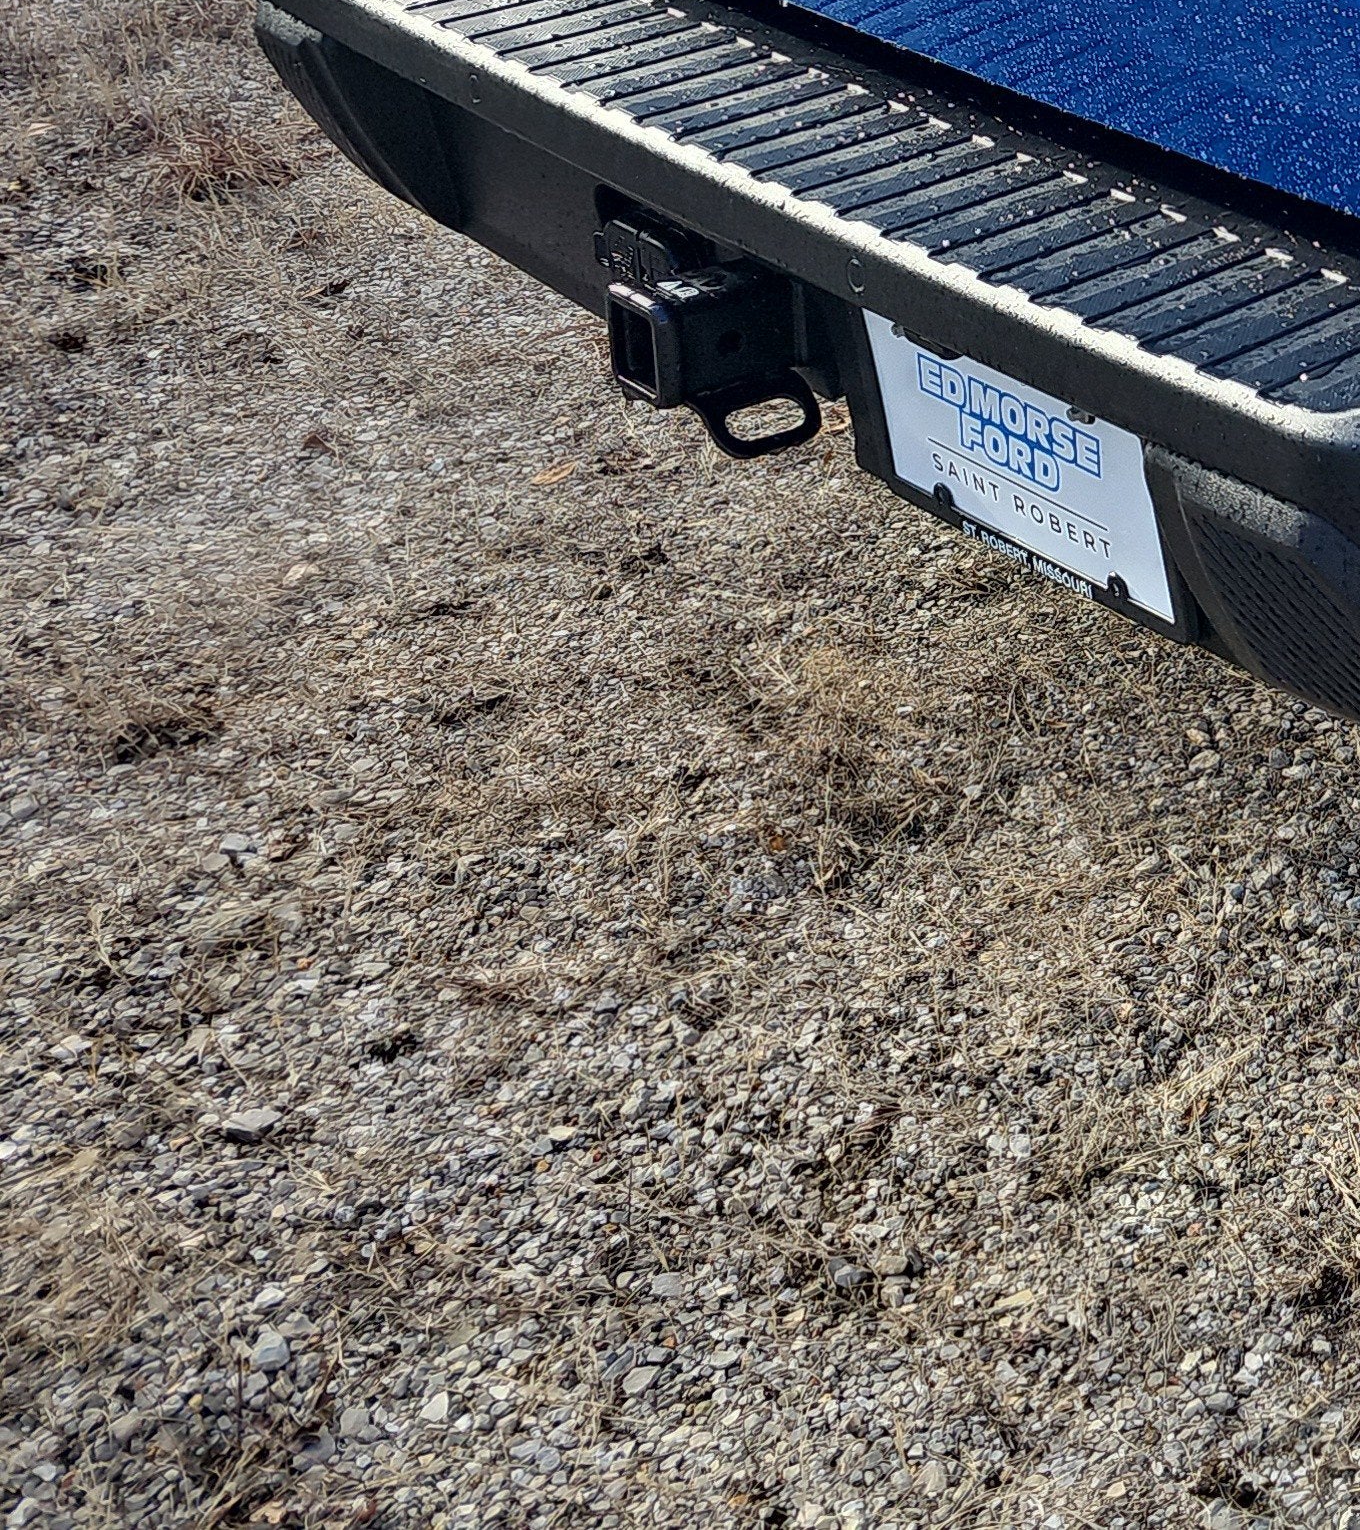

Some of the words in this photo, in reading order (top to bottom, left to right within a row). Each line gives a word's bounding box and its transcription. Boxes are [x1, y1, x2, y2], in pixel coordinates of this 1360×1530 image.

[917, 352, 968, 409] ED
[968, 375, 1101, 479] MORSE
[959, 410, 1060, 492] FORD
[932, 452, 999, 502] SAINT
[1013, 494, 1111, 559] ROBERT
[962, 520, 980, 540] ST.
[981, 531, 1031, 571] ROBERT,
[1032, 555, 1093, 600] MISSOURI
